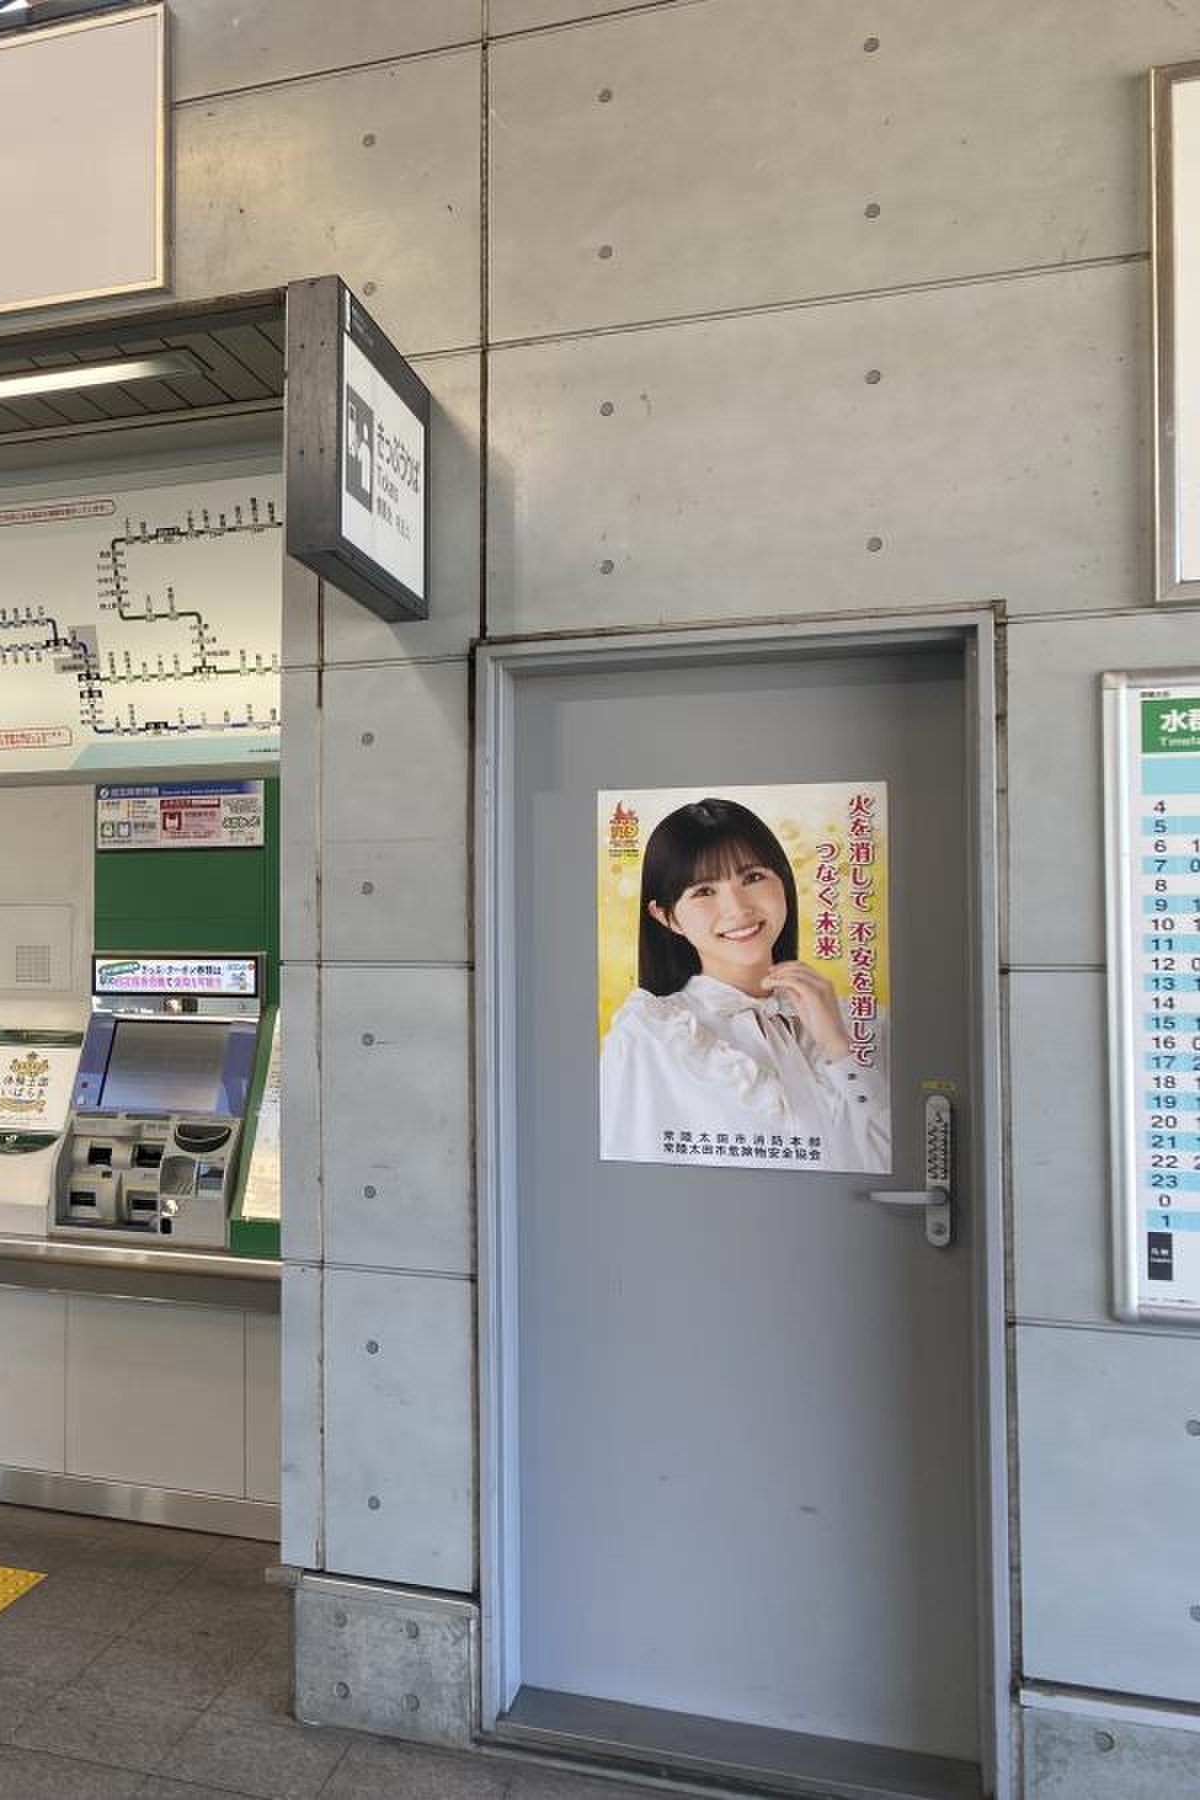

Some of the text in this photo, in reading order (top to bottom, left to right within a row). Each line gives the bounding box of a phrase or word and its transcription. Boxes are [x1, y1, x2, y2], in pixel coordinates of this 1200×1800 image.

[1153, 799, 1166, 814] 4
[1153, 819, 1167, 833] 5
[1154, 839, 1167, 853] 6
[1154, 859, 1167, 873] 7
[1155, 879, 1167, 892] 8
[815, 842, 840, 960] つなぐ未来
[1155, 899, 1168, 912] 9
[848, 794, 877, 1068] 火を消して 不安を消して
[1152, 918, 1174, 932] 10
[1152, 938, 1173, 951] 11
[1152, 958, 1175, 971] 12
[1152, 977, 1175, 991] 13
[1152, 997, 1174, 1010] 14
[1152, 1016, 1175, 1030] 15
[1152, 1036, 1176, 1049] 16
[1152, 1056, 1176, 1069] 17
[1152, 1075, 1176, 1089] 18
[1152, 1095, 1176, 1109] 19
[1152, 1115, 1177, 1129] 20
[663, 1130, 822, 1148] 常陸太田市消防本部
[1152, 1134, 1176, 1149] 21
[663, 1142, 822, 1162] 常陸太田市危険物安全協会
[1152, 1154, 1178, 1169] 22
[1152, 1173, 1178, 1189] 23
[1160, 1194, 1171, 1208] 0
[1161, 1215, 1169, 1228] 1
